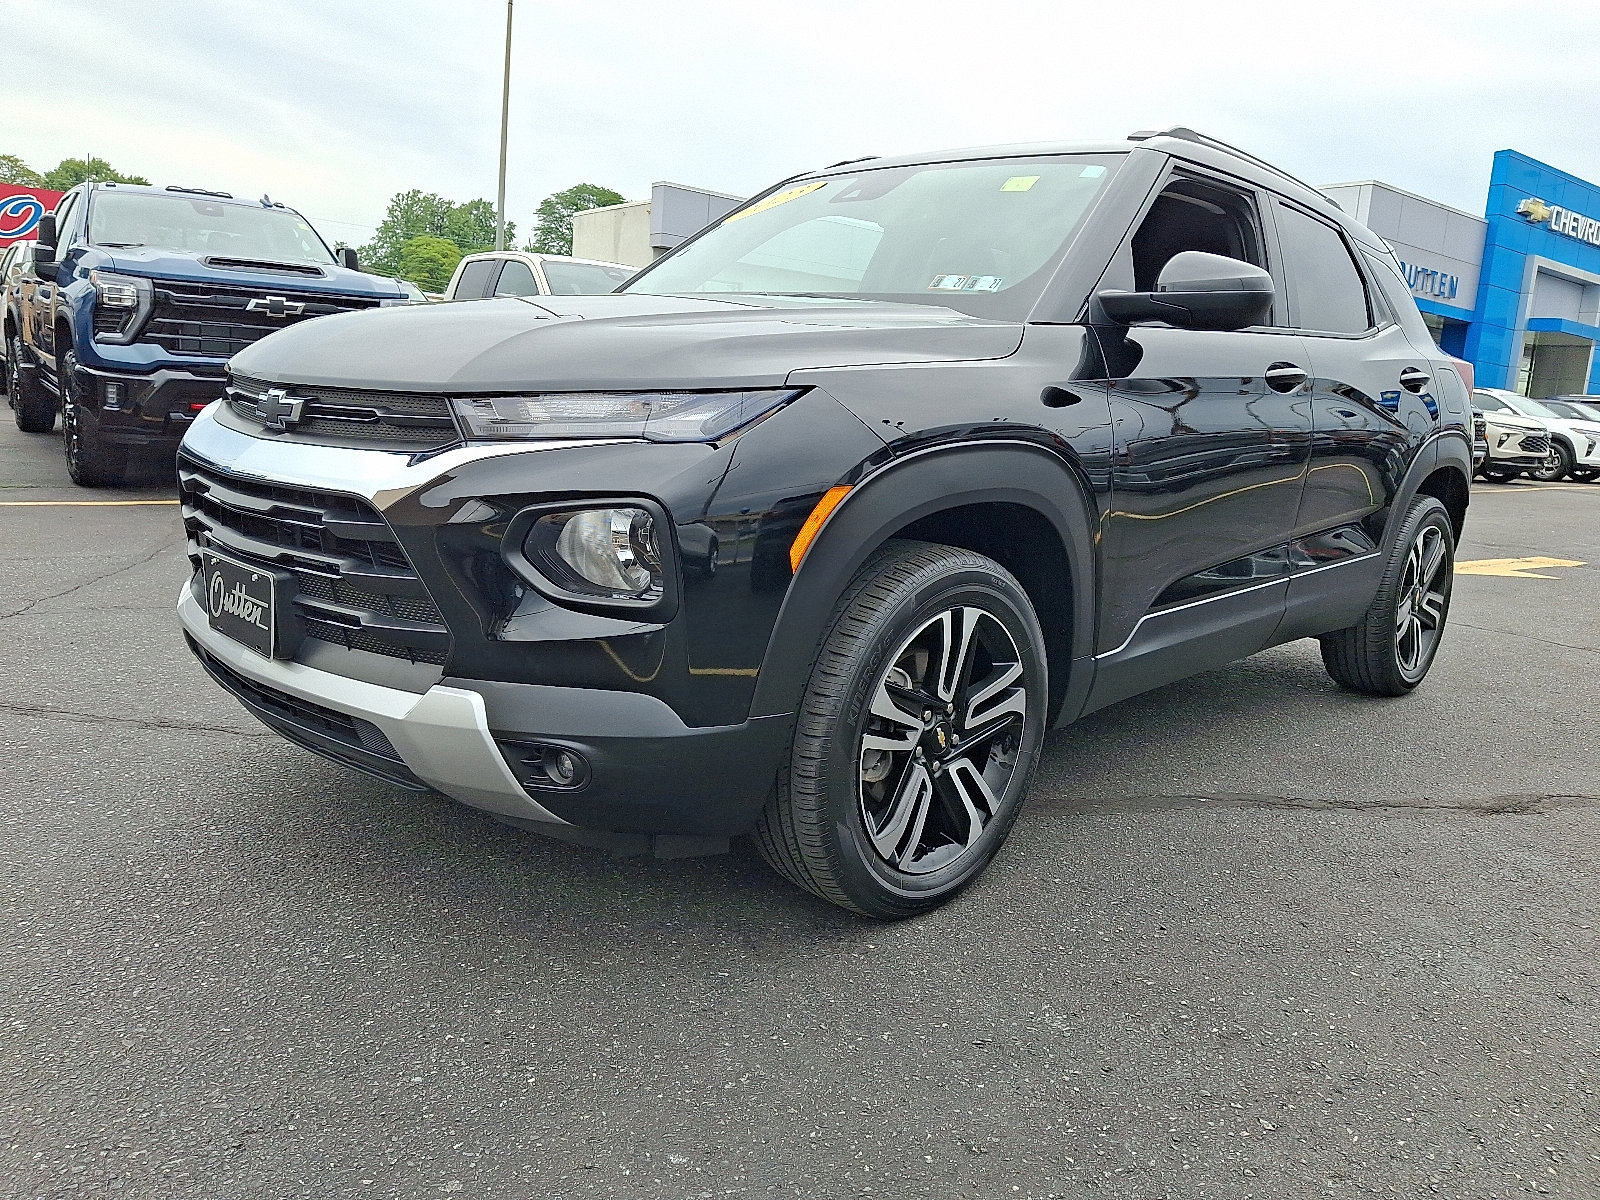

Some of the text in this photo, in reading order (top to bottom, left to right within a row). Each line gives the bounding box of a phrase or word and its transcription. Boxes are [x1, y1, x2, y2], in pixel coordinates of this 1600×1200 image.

[953, 277, 966, 288] 27
[988, 278, 1002, 289] 27
[209, 570, 269, 631] Outten
